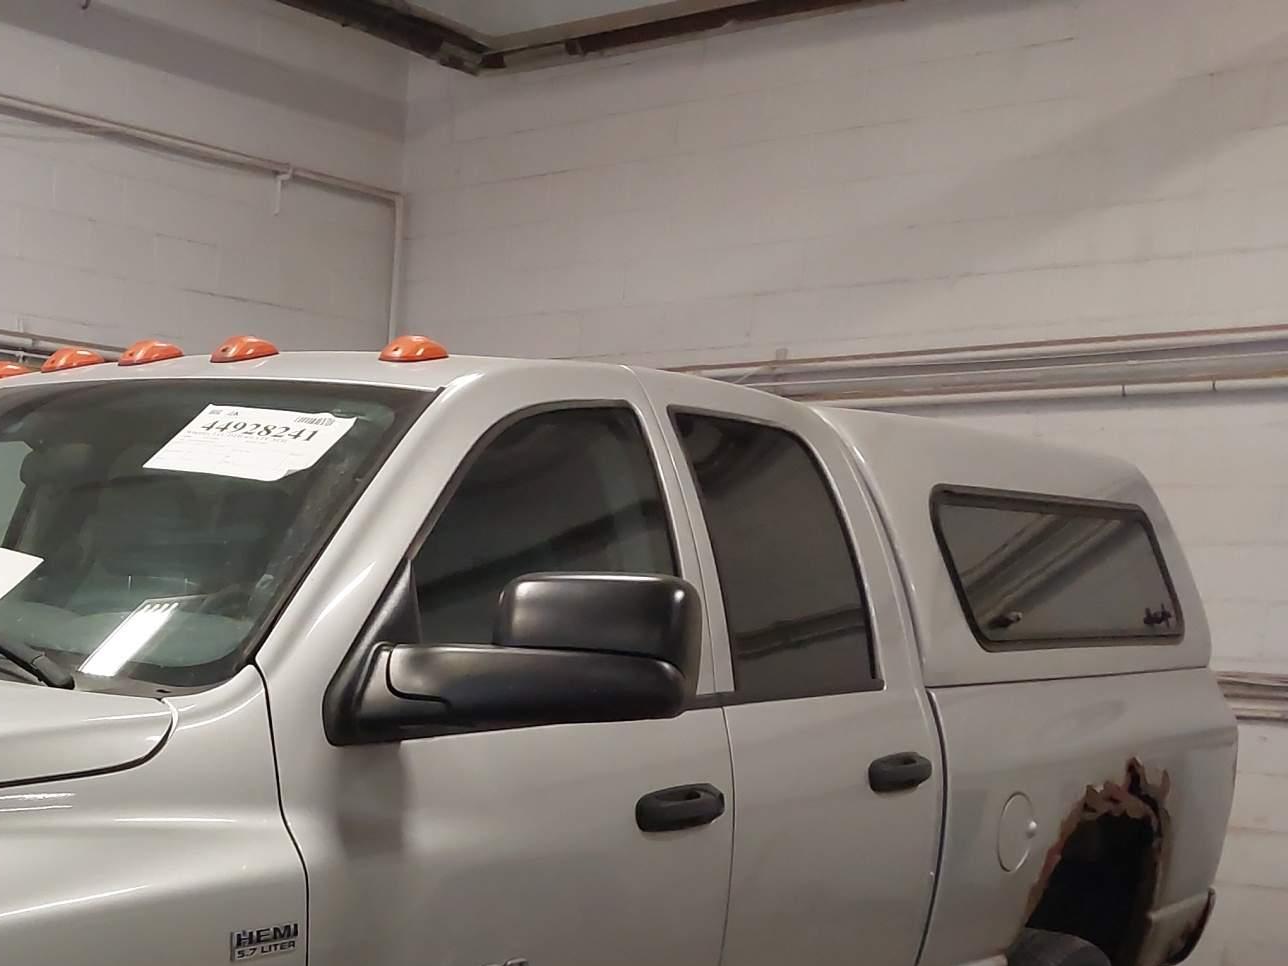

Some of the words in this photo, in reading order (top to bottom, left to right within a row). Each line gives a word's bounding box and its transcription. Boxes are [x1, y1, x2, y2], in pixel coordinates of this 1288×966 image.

[200, 420, 319, 441] 44928241
[236, 923, 299, 947] HEMI
[237, 947, 257, 959] 5.7
[261, 940, 295, 953] LITER
